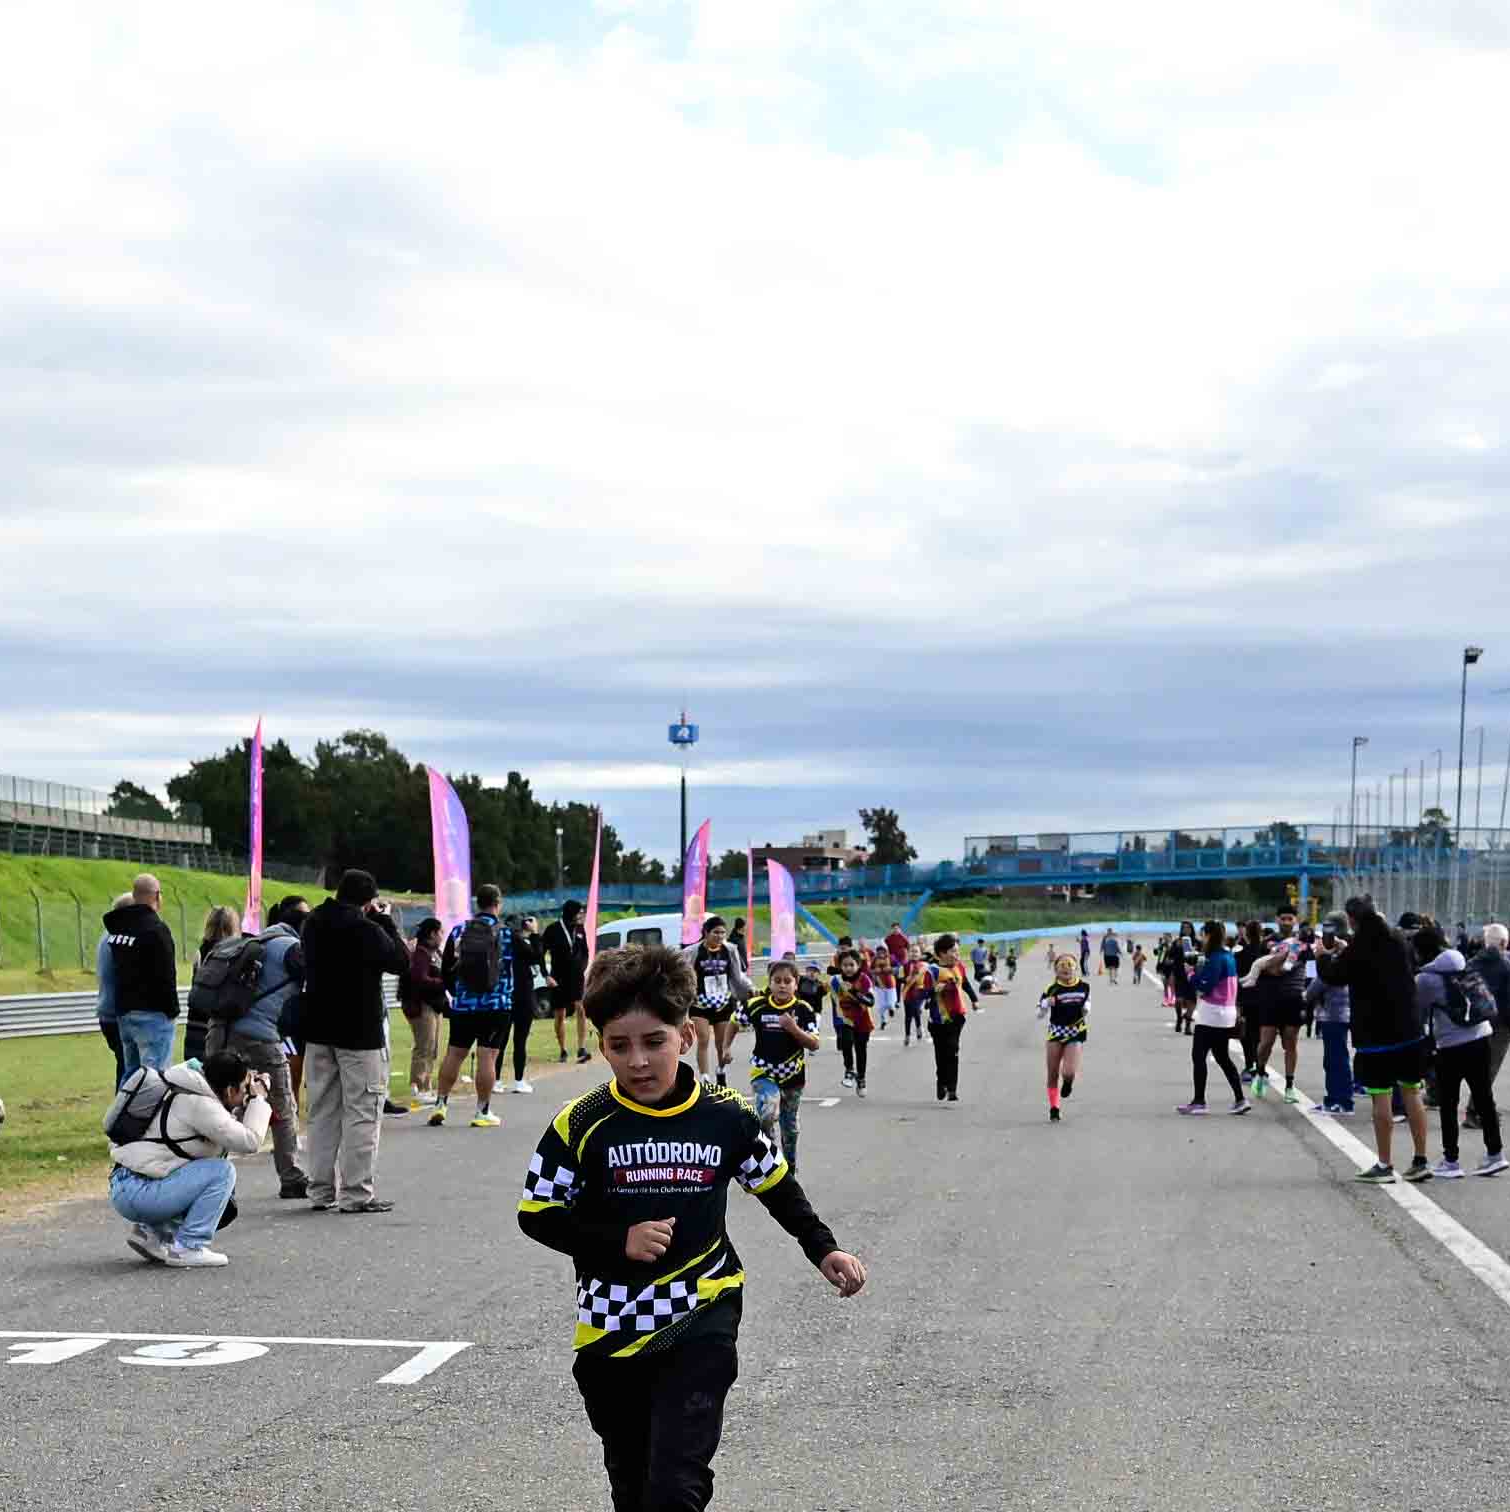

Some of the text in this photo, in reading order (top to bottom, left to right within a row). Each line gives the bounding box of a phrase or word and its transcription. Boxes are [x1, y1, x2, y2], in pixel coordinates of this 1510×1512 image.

[608, 1137, 722, 1168] AUTÓDROMO
[626, 1167, 703, 1183] RUNNING RACE
[6, 1338, 270, 1366] 19
